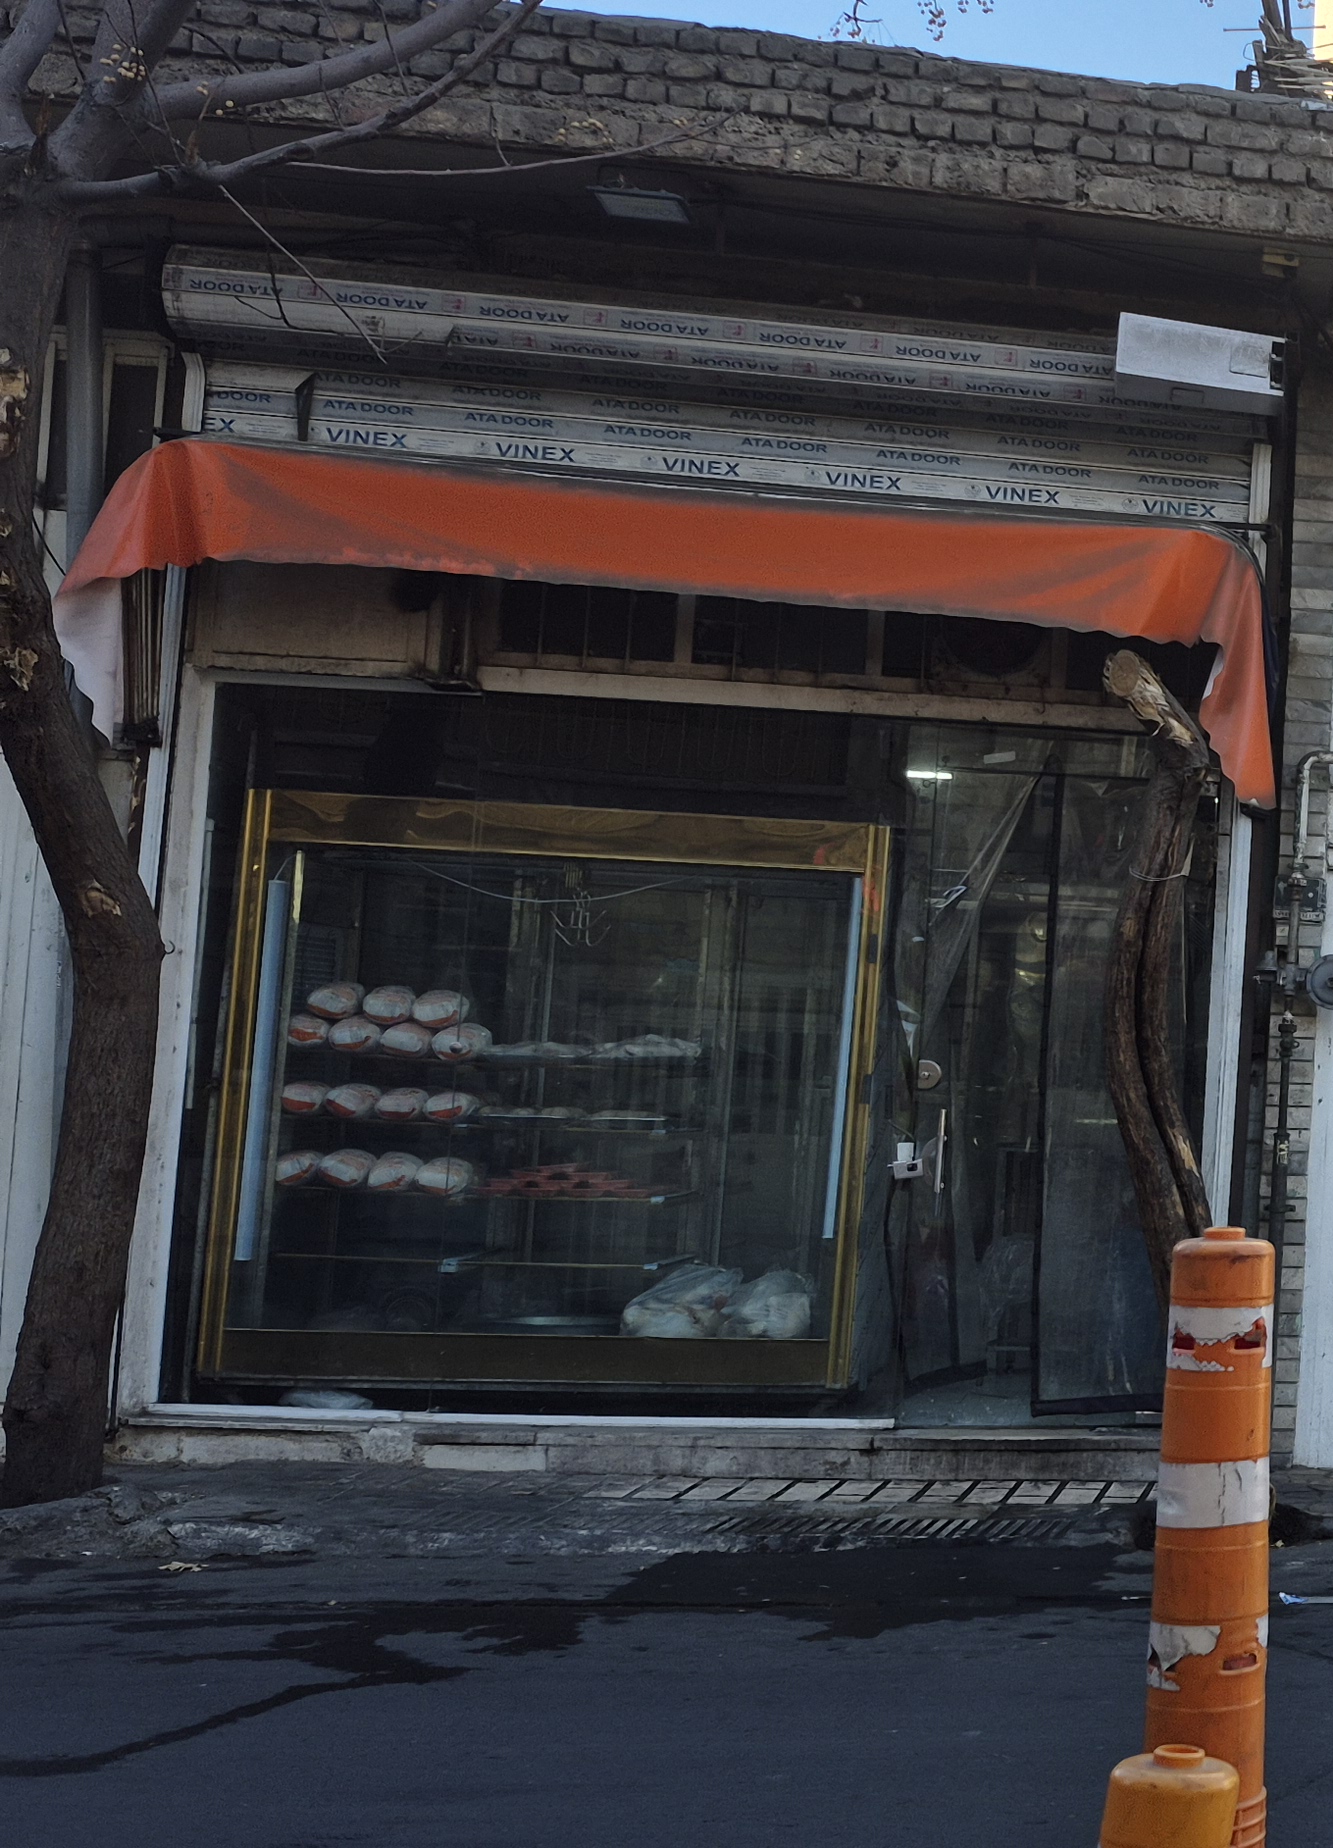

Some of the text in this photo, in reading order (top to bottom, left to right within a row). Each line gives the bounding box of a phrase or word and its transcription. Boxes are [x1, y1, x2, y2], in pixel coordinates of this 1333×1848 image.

[326, 427, 407, 449] VINEX
[495, 442, 575, 463] VINEX
[662, 456, 740, 477] VINEX
[826, 470, 901, 491] VINEX
[985, 485, 1060, 505] VINEX
[1142, 498, 1217, 519] VINEX
